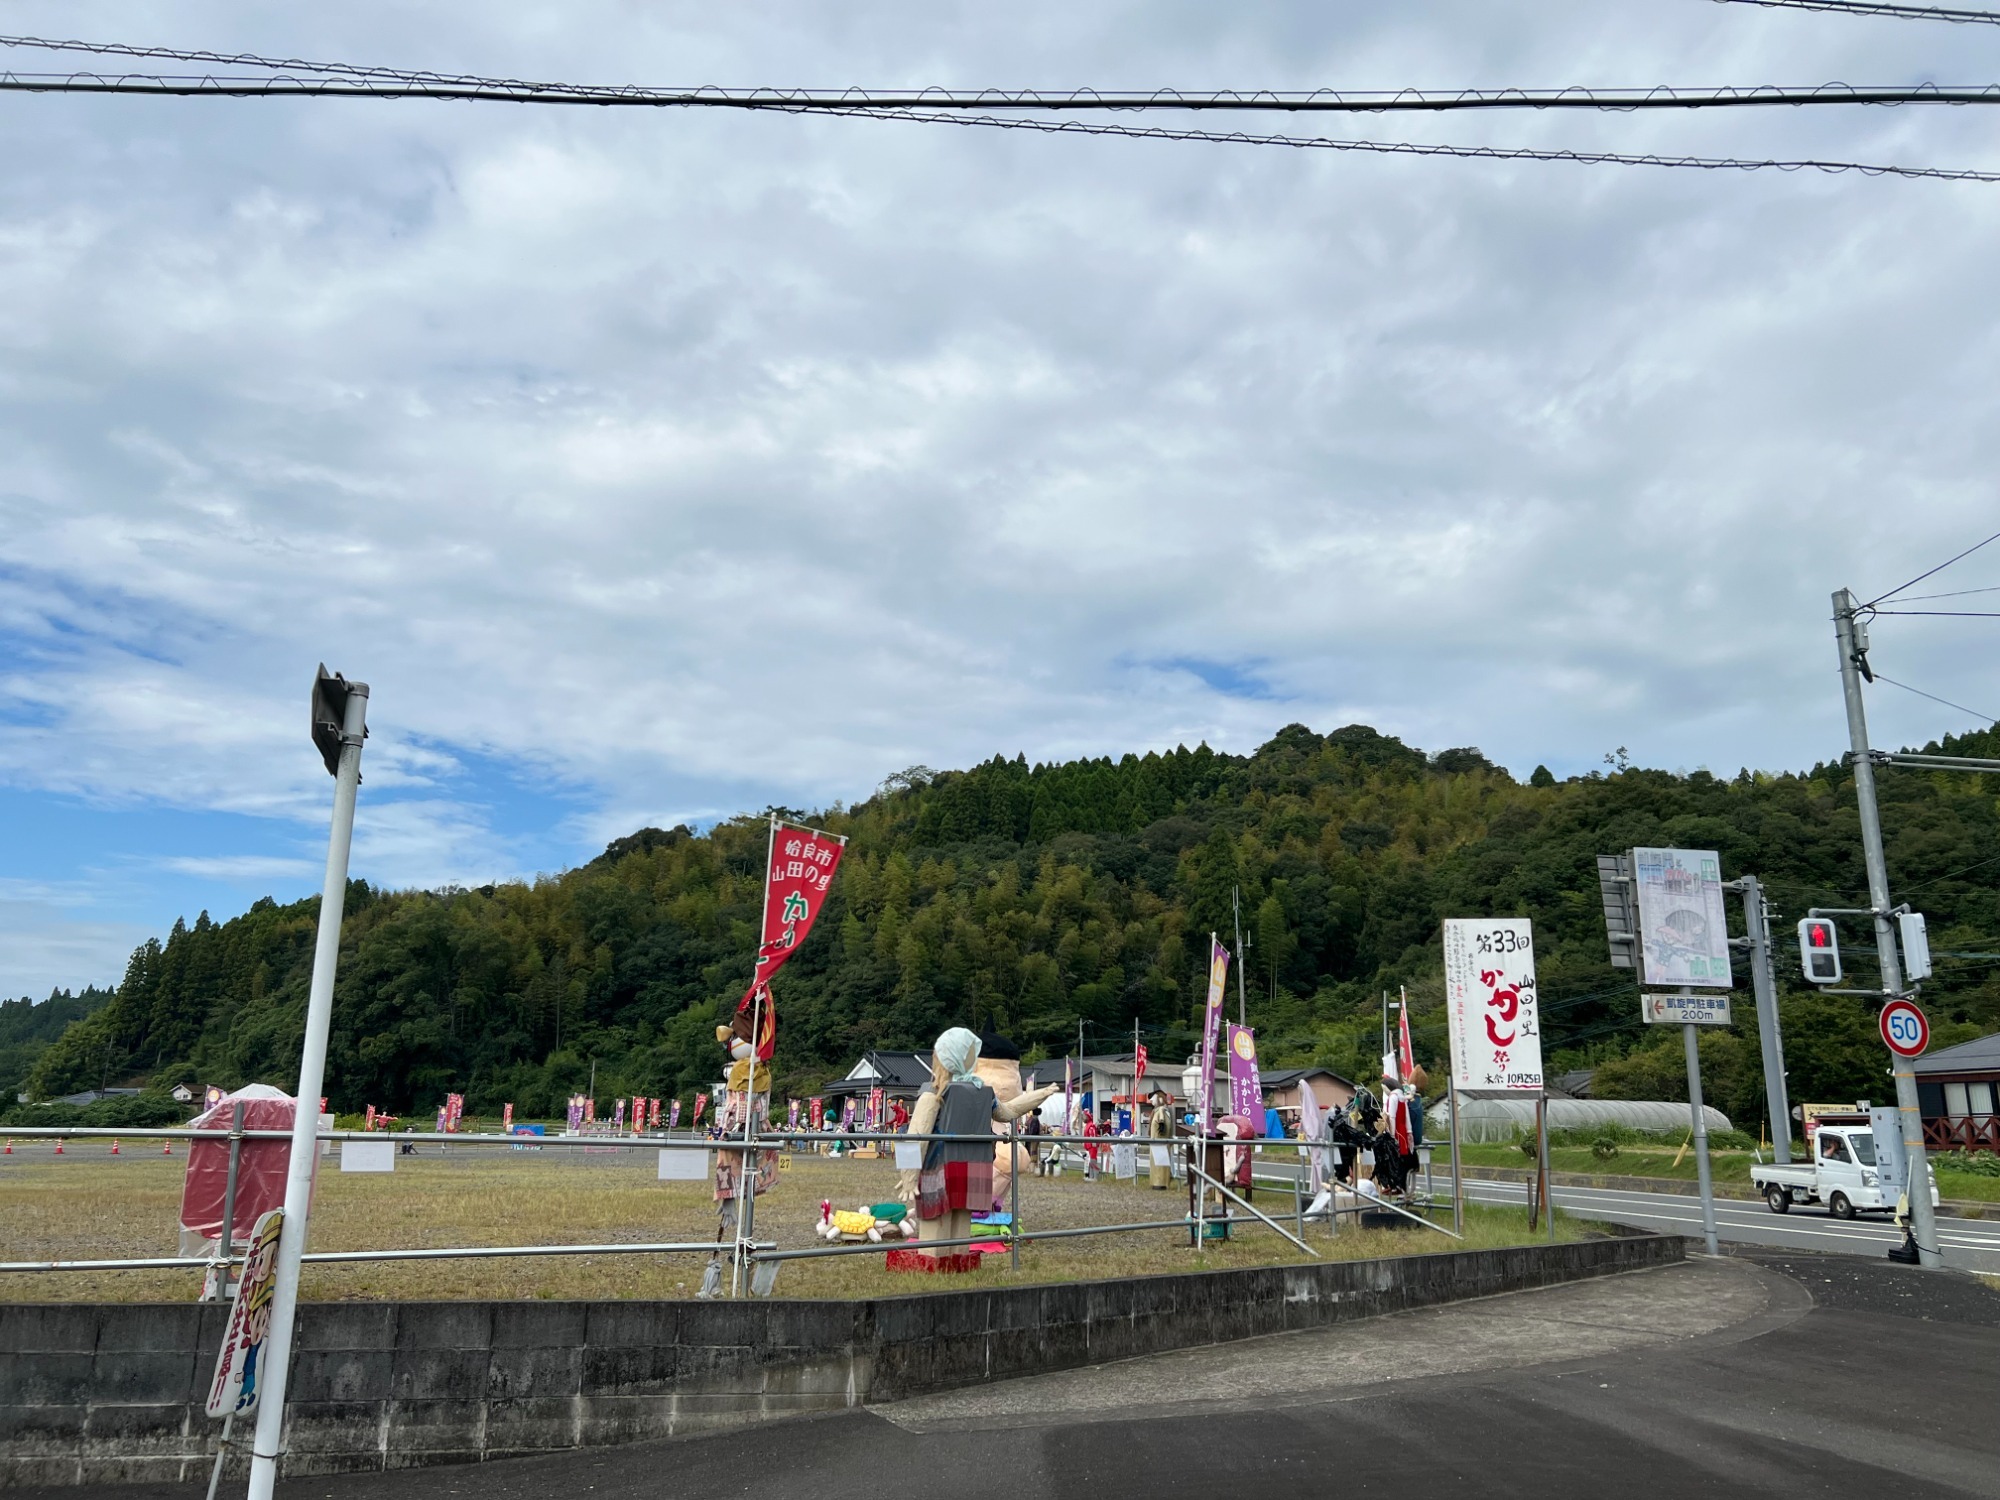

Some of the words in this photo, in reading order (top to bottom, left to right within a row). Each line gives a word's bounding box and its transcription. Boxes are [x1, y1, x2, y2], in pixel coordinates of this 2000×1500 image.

[785, 839, 833, 867] 姶良市
[772, 861, 831, 891] 山田の里
[1519, 974, 1538, 1037] 山田の里
[1666, 997, 1727, 1010] 凱旋門駐車場
[1682, 1010, 1714, 1021] 200m
[1890, 1015, 1919, 1041] 50
[1238, 1031, 1251, 1059] 山田
[1507, 1073, 1541, 1084] 10月25日
[1240, 1076, 1251, 1117] かかしの
[780, 1158, 791, 1169] 27
